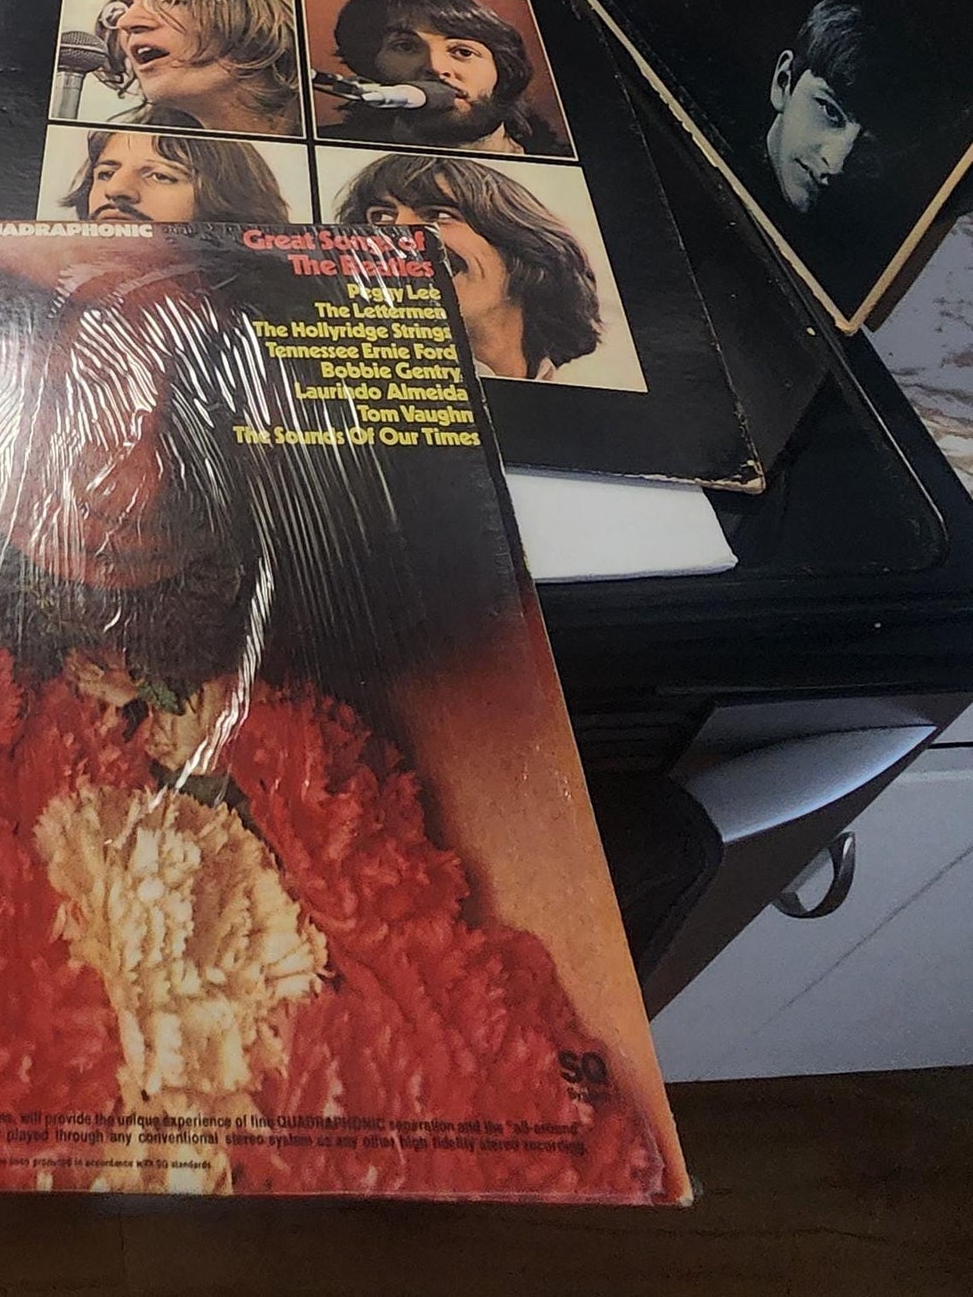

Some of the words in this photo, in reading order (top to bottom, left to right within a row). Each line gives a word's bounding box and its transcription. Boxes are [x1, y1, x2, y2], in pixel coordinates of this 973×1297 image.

[242, 229, 317, 251] Great
[398, 230, 426, 252] of
[288, 254, 338, 276] The
[339, 254, 435, 278] Beatles
[406, 284, 442, 301] Lee
[315, 302, 351, 319] The
[353, 303, 448, 320] Lettermen
[252, 321, 289, 338] The
[291, 321, 389, 342] Hollyridge
[392, 323, 452, 342] Strings
[265, 342, 359, 359] Tennessee
[362, 342, 410, 360] Ernie
[413, 343, 458, 361] Ford
[320, 362, 392, 380] Bobbie
[395, 363, 462, 383] Gentry
[294, 382, 382, 400] Laurindo
[387, 383, 469, 402] Almeida
[357, 405, 400, 423] Tom
[402, 405, 474, 426] Vaughn
[233, 426, 271, 444] The
[274, 426, 344, 445] Sounds
[348, 427, 375, 445] Of
[379, 427, 419, 445] Our
[422, 428, 481, 446] Times
[21, 1111, 41, 1123] will
[44, 1112, 91, 1126] provide
[95, 1113, 115, 1125] the
[118, 1112, 160, 1129] unique
[163, 1114, 232, 1128] experience
[235, 1114, 247, 1127] of
[277, 1115, 386, 1130] QUADRAPHONIC
[6, 1128, 49, 1143] played
[55, 1129, 104, 1145] through
[110, 1132, 132, 1146] any
[138, 1131, 219, 1144] conventional
[225, 1133, 264, 1145] stereo
